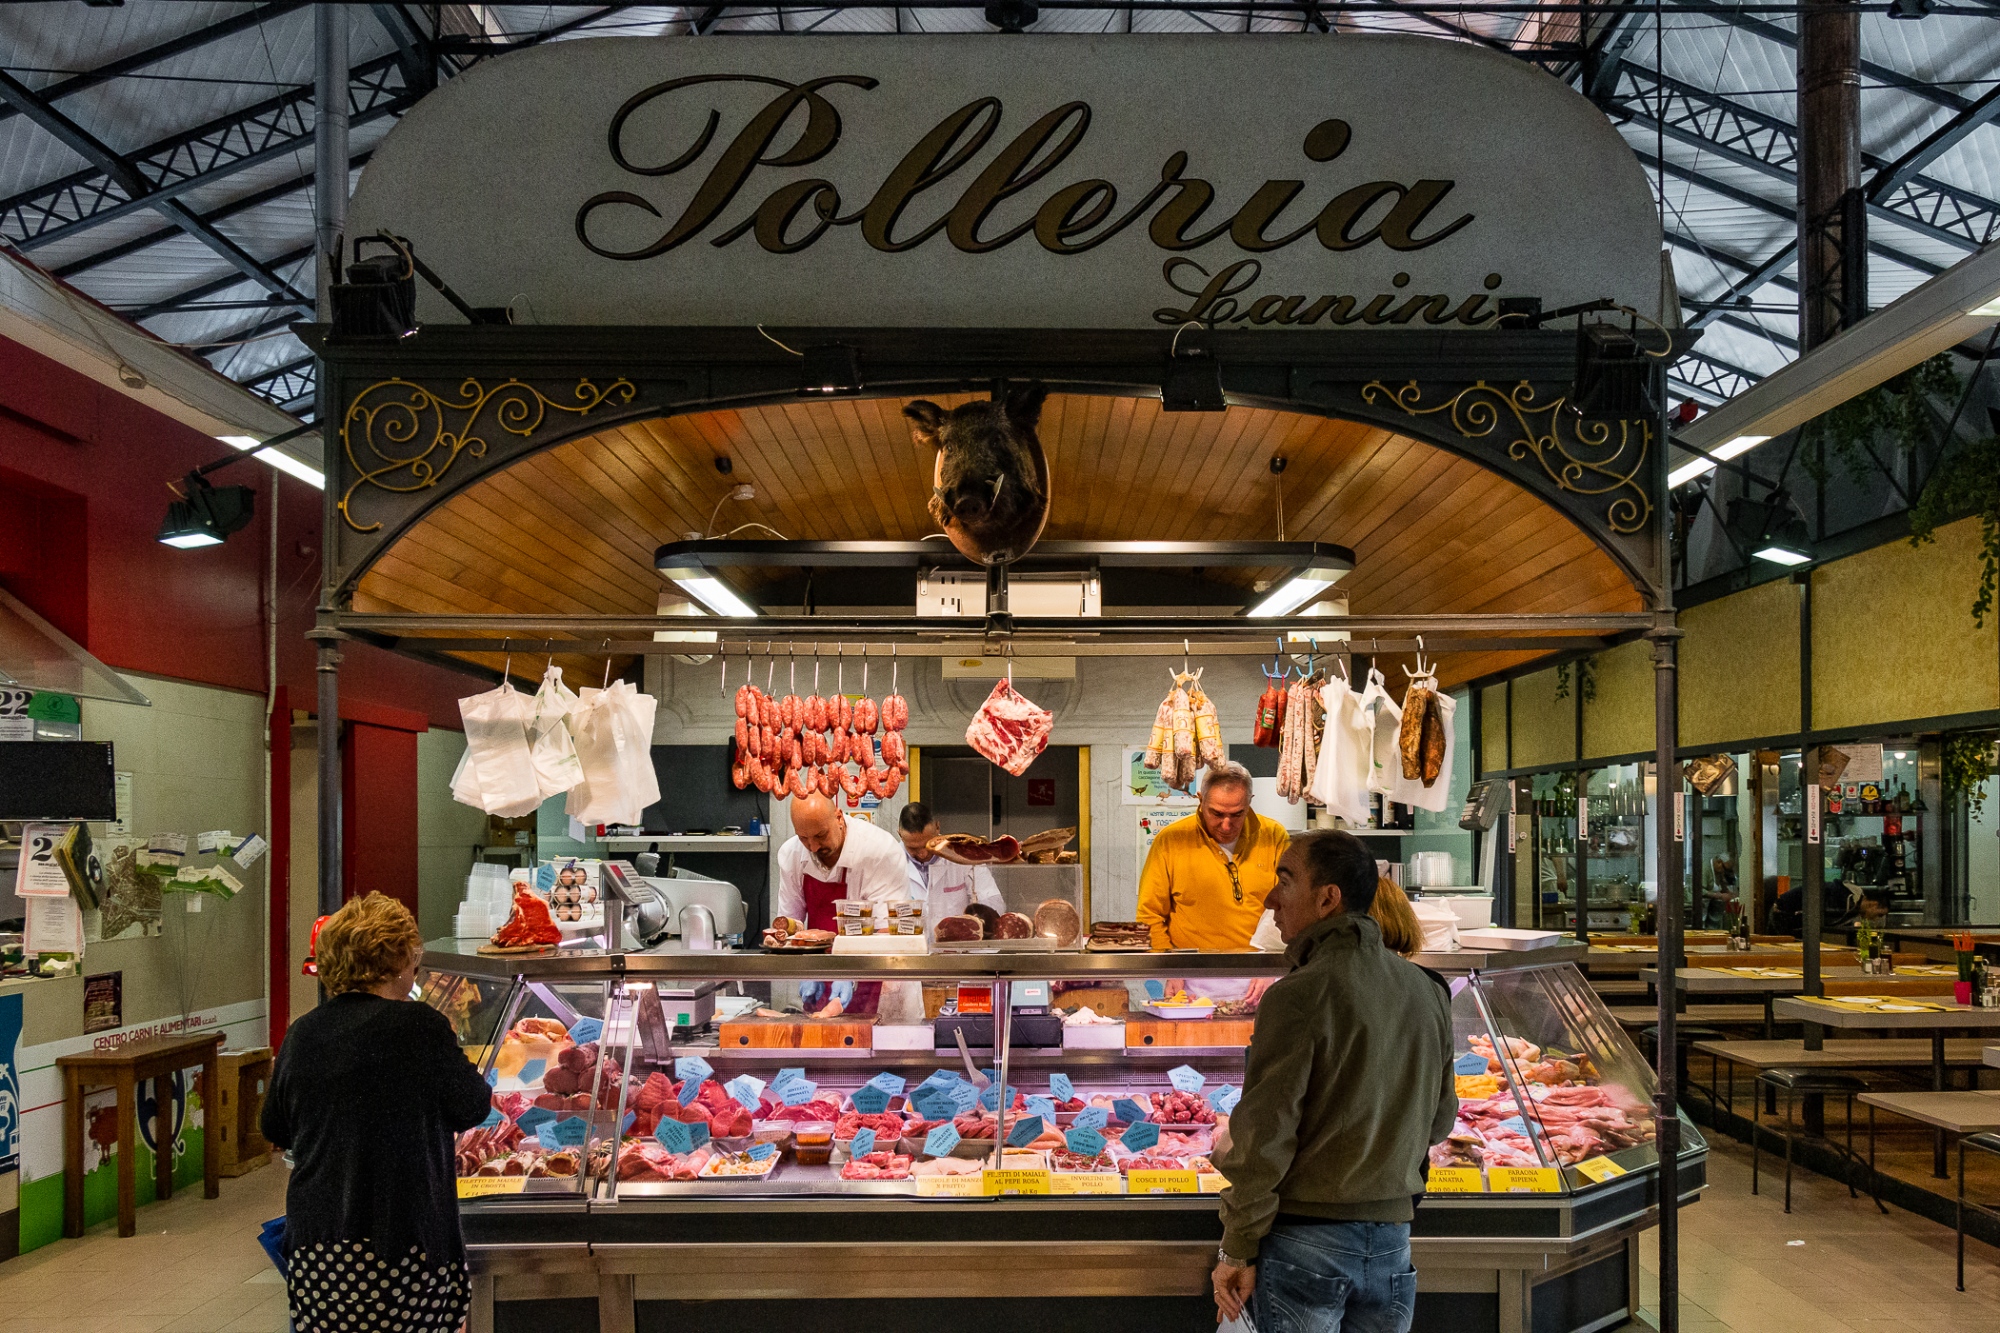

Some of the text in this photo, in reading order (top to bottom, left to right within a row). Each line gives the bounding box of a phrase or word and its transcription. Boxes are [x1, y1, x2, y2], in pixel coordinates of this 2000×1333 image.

[576, 73, 1476, 261] Polleria
[1153, 257, 1502, 329] Lanini
[94, 1032, 127, 1049] CENTRO
[129, 1026, 152, 1041] CARNI
[153, 1025, 159, 1036] E
[160, 1016, 201, 1034] ALIMENTARI
